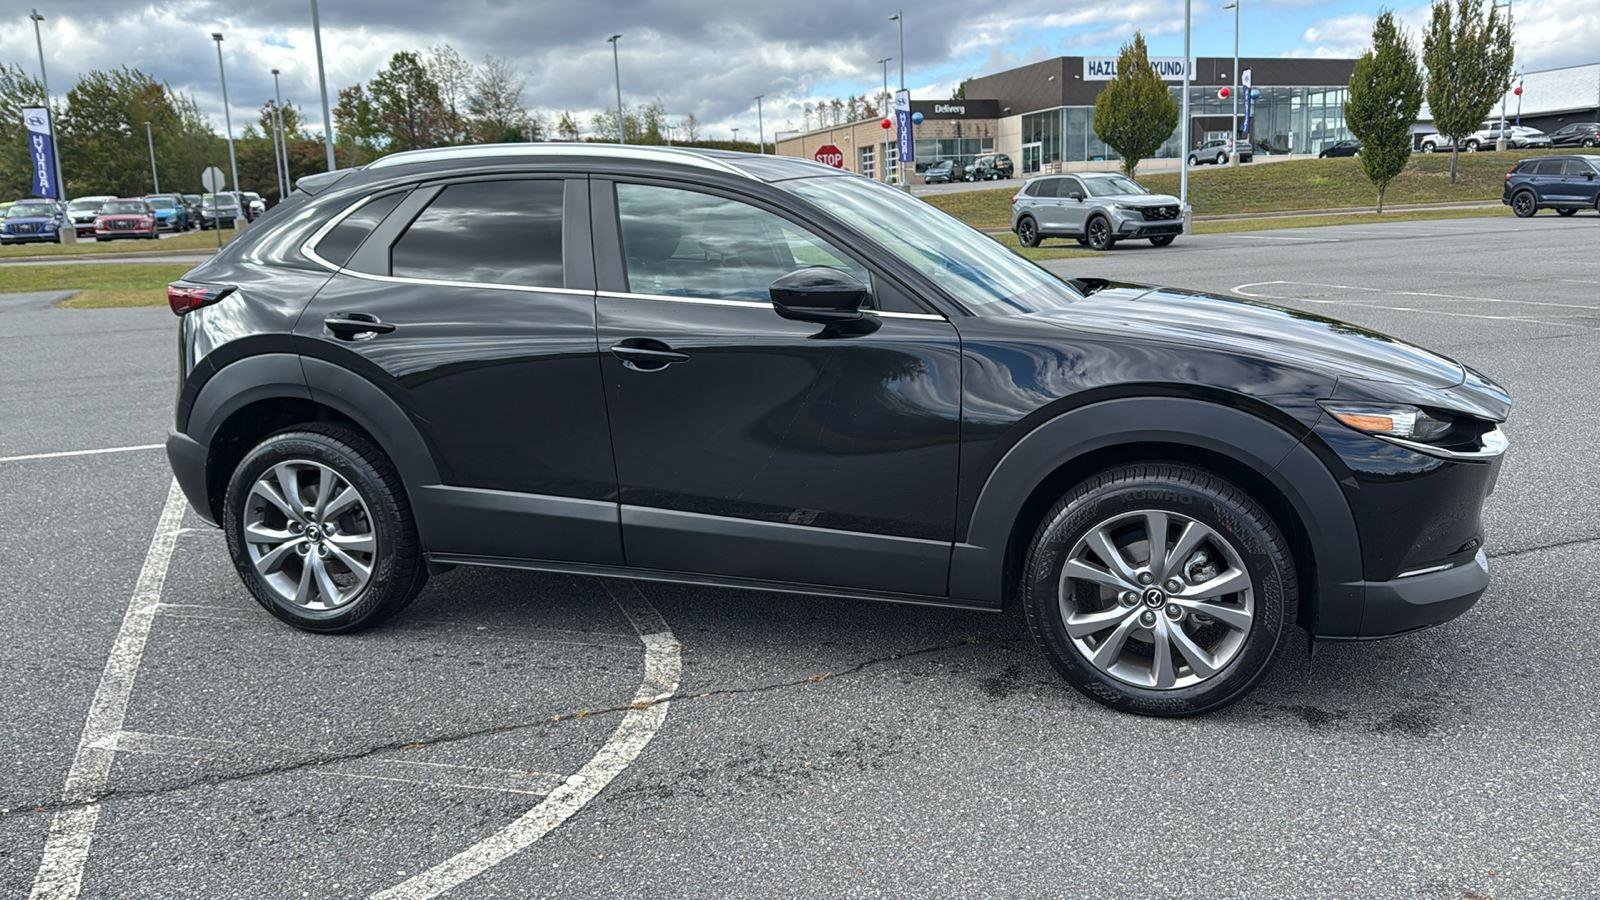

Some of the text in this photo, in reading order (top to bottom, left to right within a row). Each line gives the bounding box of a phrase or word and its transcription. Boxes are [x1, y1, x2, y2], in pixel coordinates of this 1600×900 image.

[934, 104, 966, 115] Delivery
[899, 112, 909, 161] HYUNDAI
[32, 135, 49, 195] HYUNDAI
[816, 153, 842, 167] STOP
